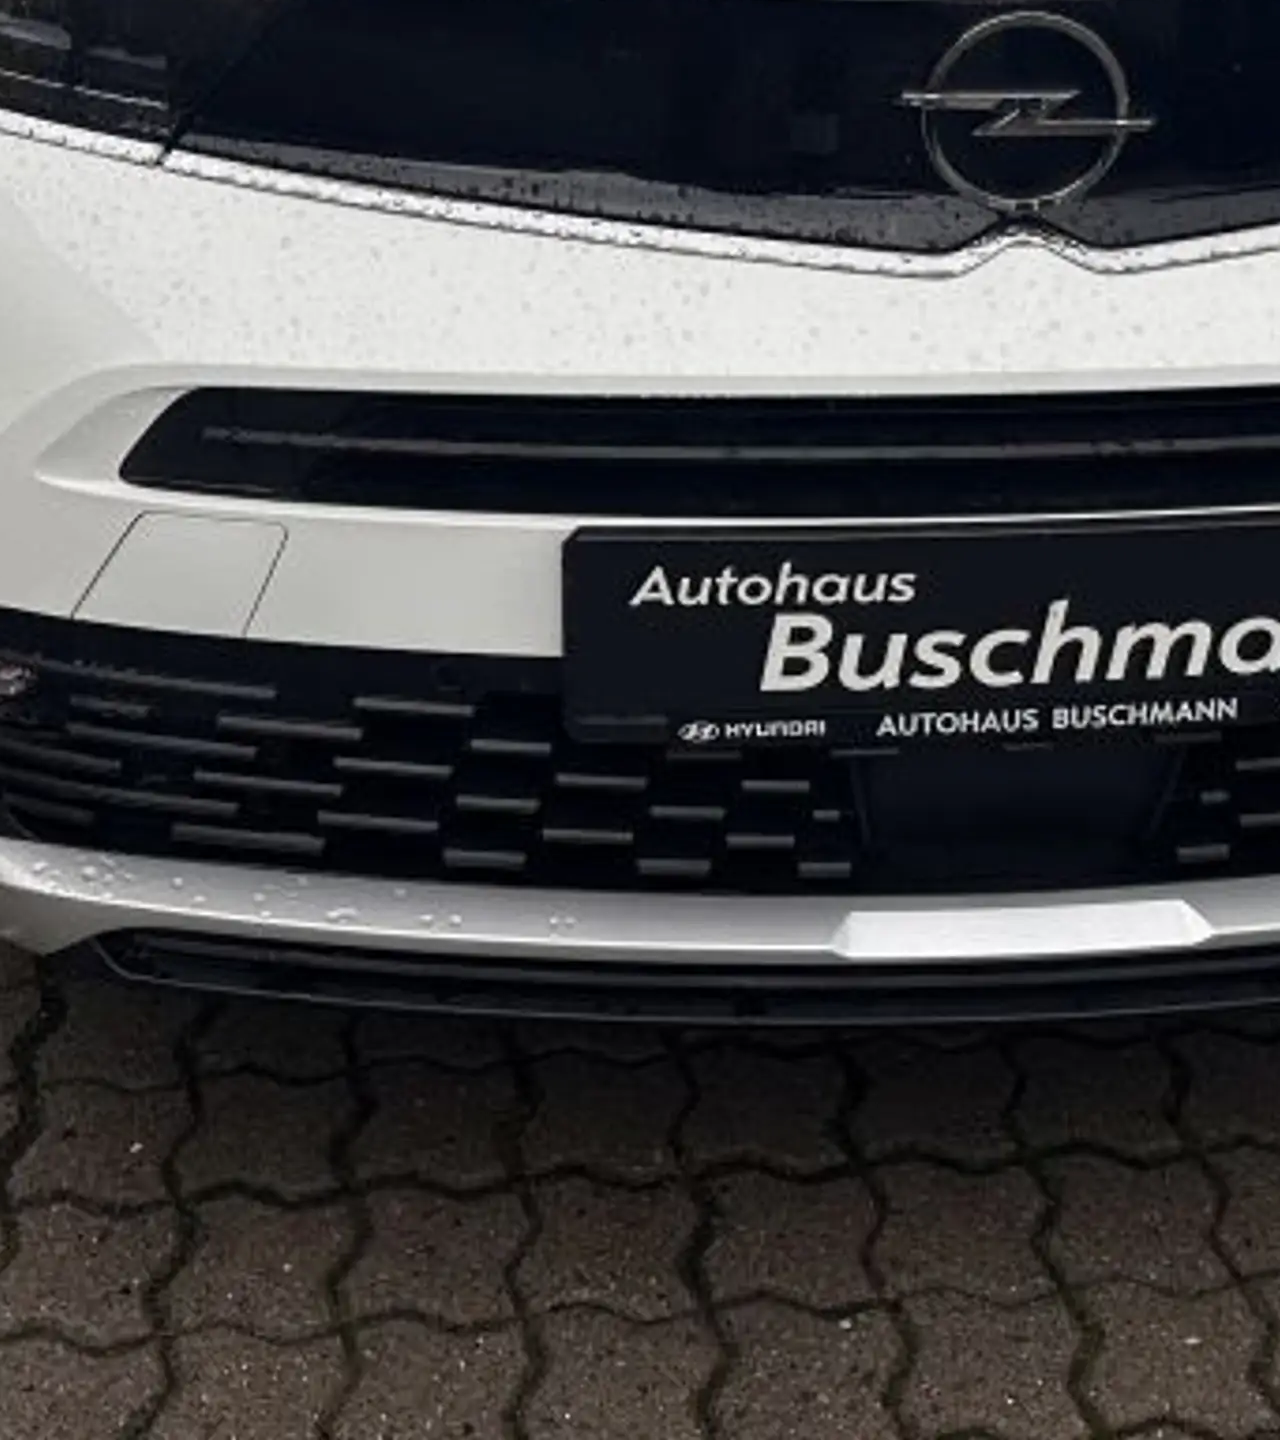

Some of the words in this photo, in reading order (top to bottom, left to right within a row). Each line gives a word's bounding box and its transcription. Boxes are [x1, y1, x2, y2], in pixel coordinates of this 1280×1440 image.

[628, 561, 918, 607] Autohaus
[724, 719, 827, 739] HYUNDAI
[875, 708, 1041, 738] AUTOHAUS
[1051, 697, 1239, 730] BUSCHMANN
